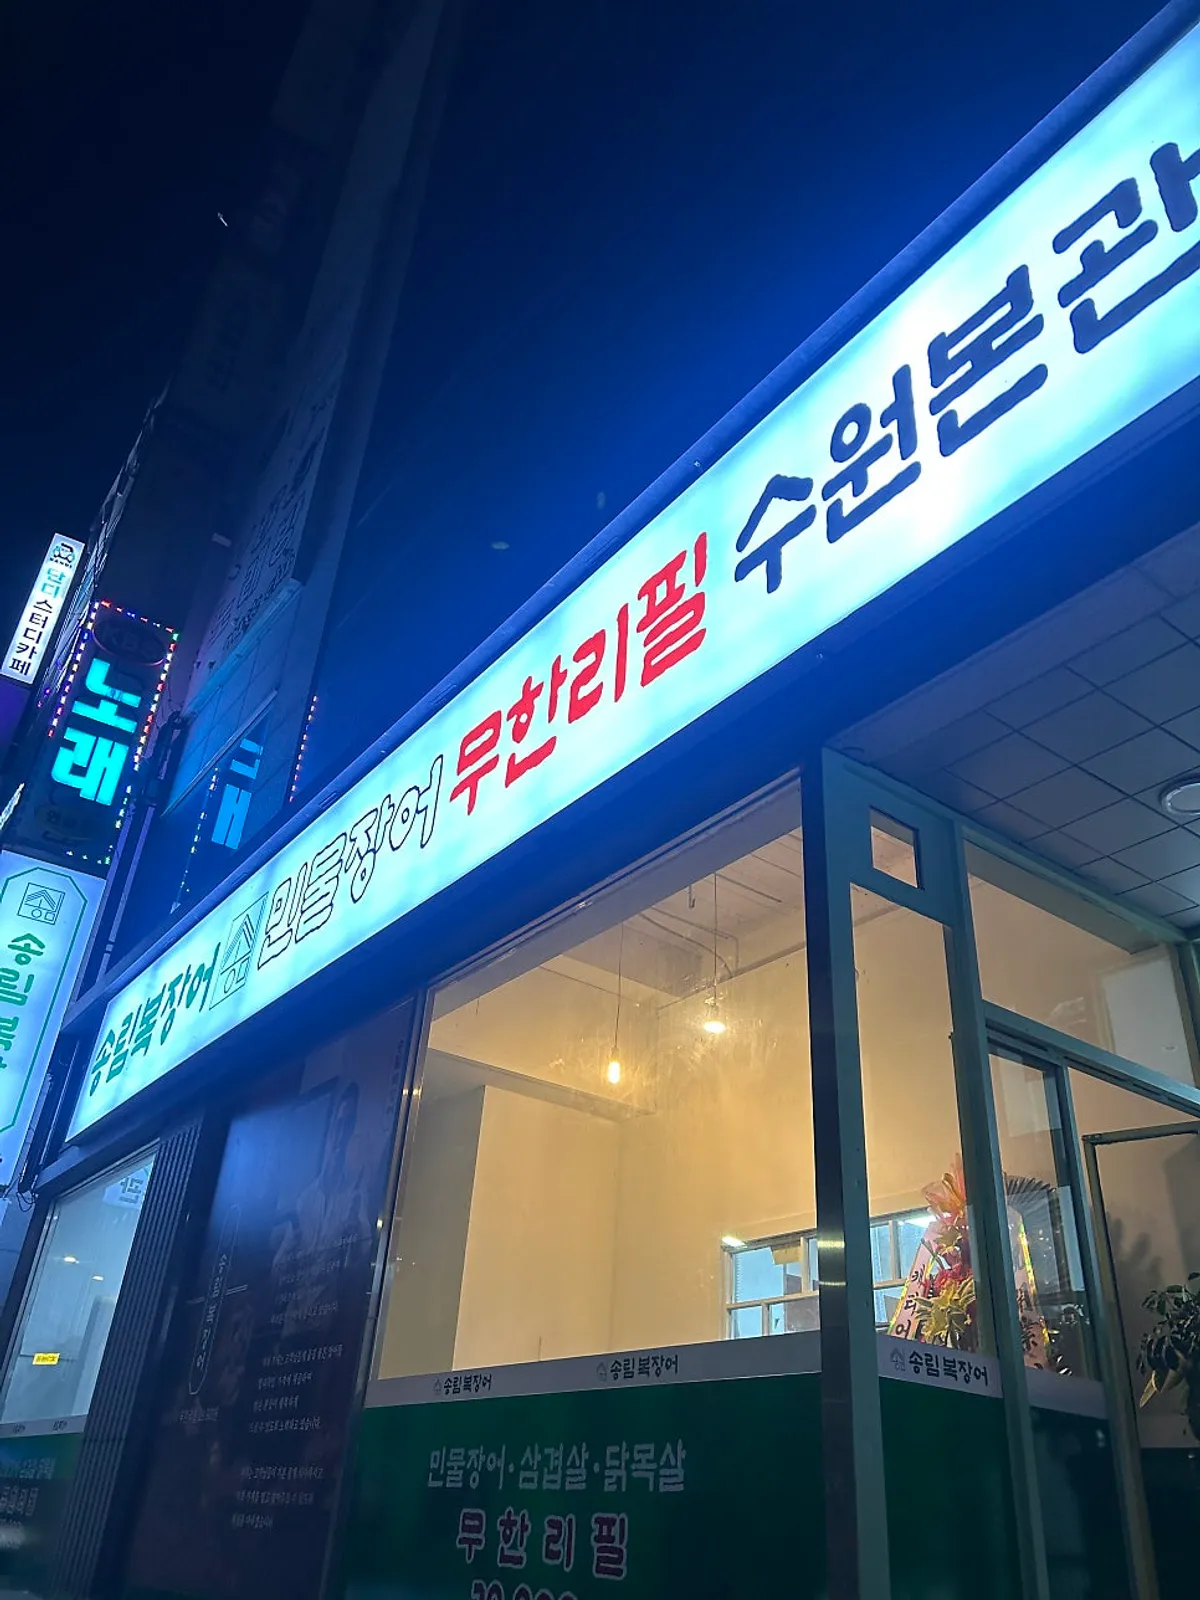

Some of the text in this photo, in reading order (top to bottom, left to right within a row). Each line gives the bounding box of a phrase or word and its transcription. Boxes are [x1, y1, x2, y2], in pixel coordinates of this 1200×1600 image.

[51, 657, 142, 806] 노래
[89, 941, 222, 1097] 송림복장어
[256, 753, 443, 970] 민물장어
[449, 531, 707, 816] 무한리필
[442, 1373, 493, 1395] 송림복장어
[609, 1354, 679, 1380] 송림복장어
[909, 1350, 989, 1386] 송림복장어
